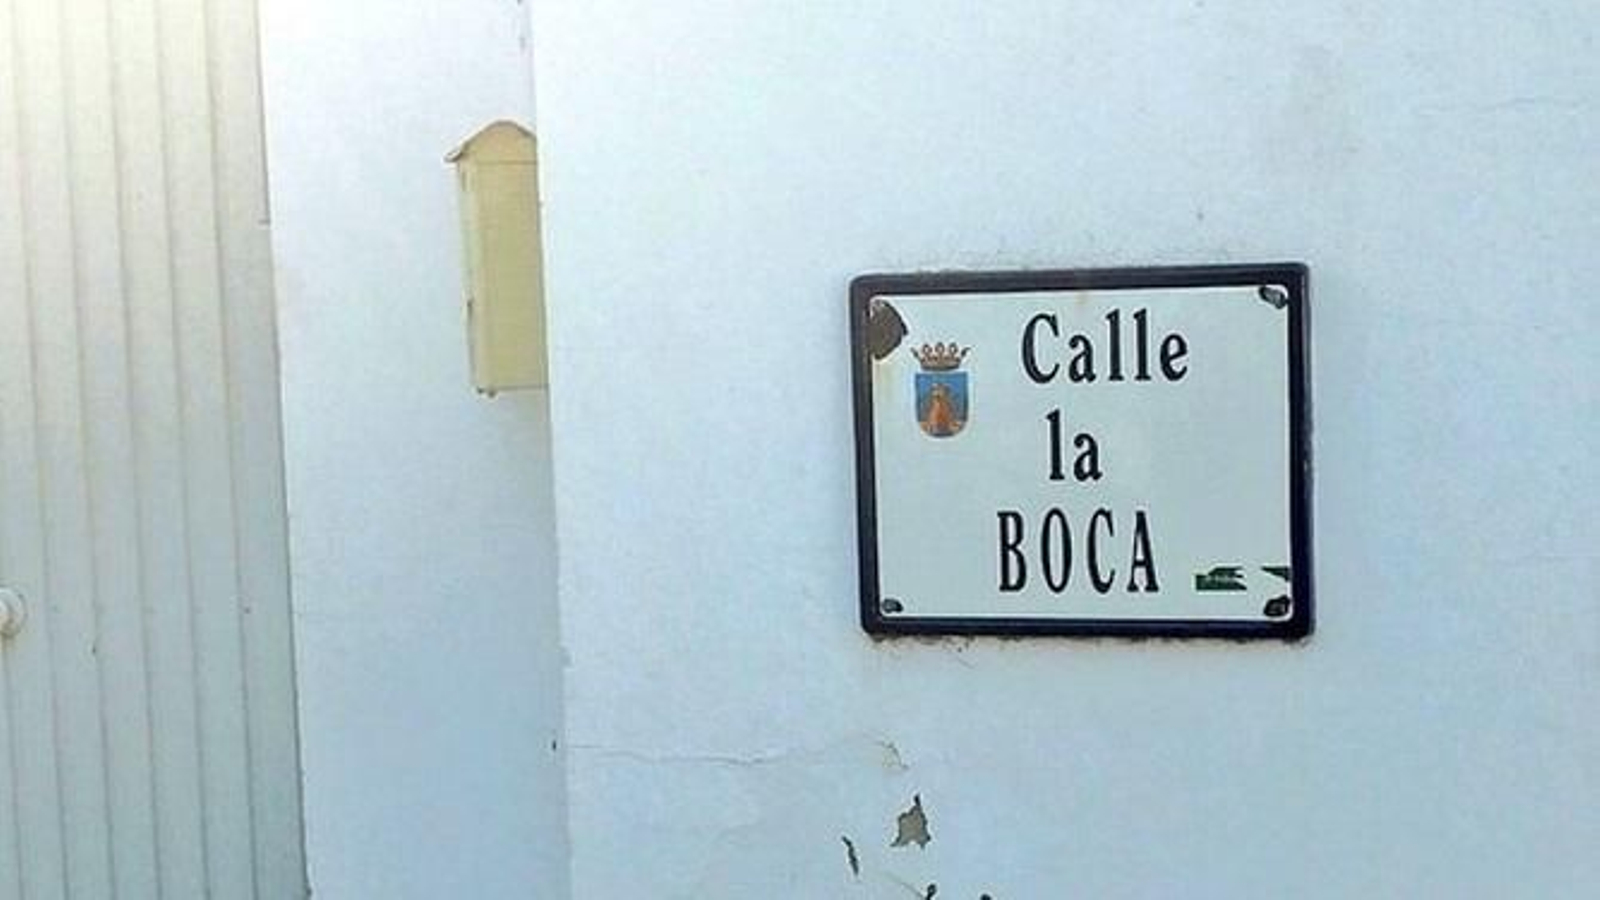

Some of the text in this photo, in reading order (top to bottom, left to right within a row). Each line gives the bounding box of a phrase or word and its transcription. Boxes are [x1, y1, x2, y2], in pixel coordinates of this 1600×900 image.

[1022, 309, 1190, 384] Calle
[1047, 409, 1103, 482] la
[997, 507, 1160, 594] BOCA
